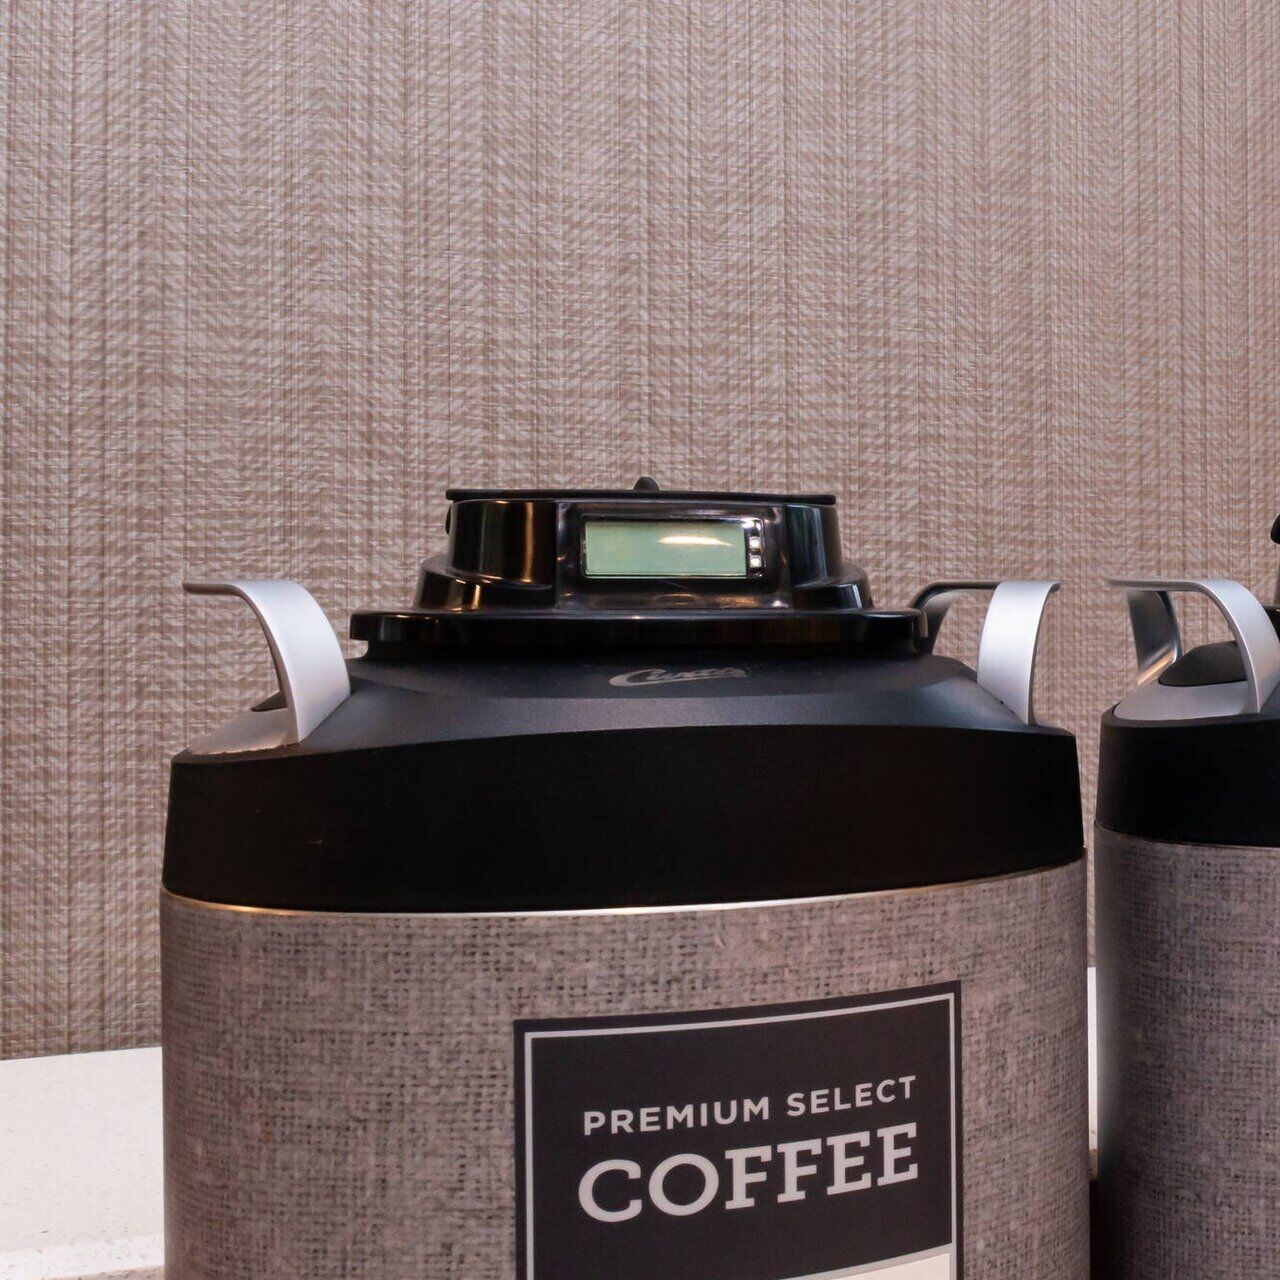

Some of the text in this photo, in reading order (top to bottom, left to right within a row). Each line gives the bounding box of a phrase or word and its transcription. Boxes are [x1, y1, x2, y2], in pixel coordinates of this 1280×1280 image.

[583, 1074, 917, 1137] PREMIUM SELECT
[578, 1122, 919, 1224] COFFEE
